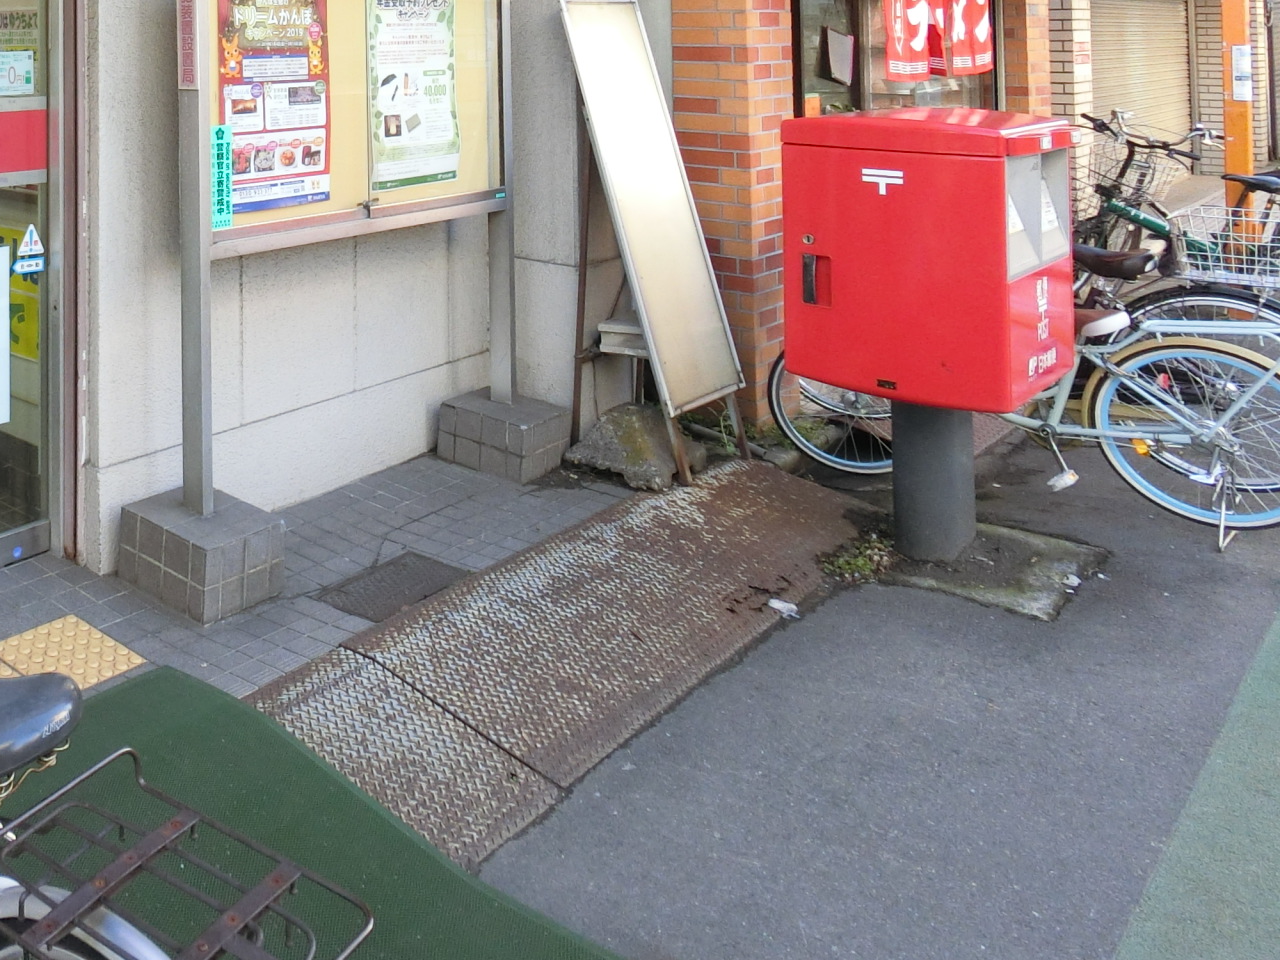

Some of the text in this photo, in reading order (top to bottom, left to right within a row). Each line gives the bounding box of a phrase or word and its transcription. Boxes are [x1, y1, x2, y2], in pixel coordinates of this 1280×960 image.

[234, 6, 313, 28] ドリームかんぽ
[246, 27, 304, 40] キャンペーン 2019
